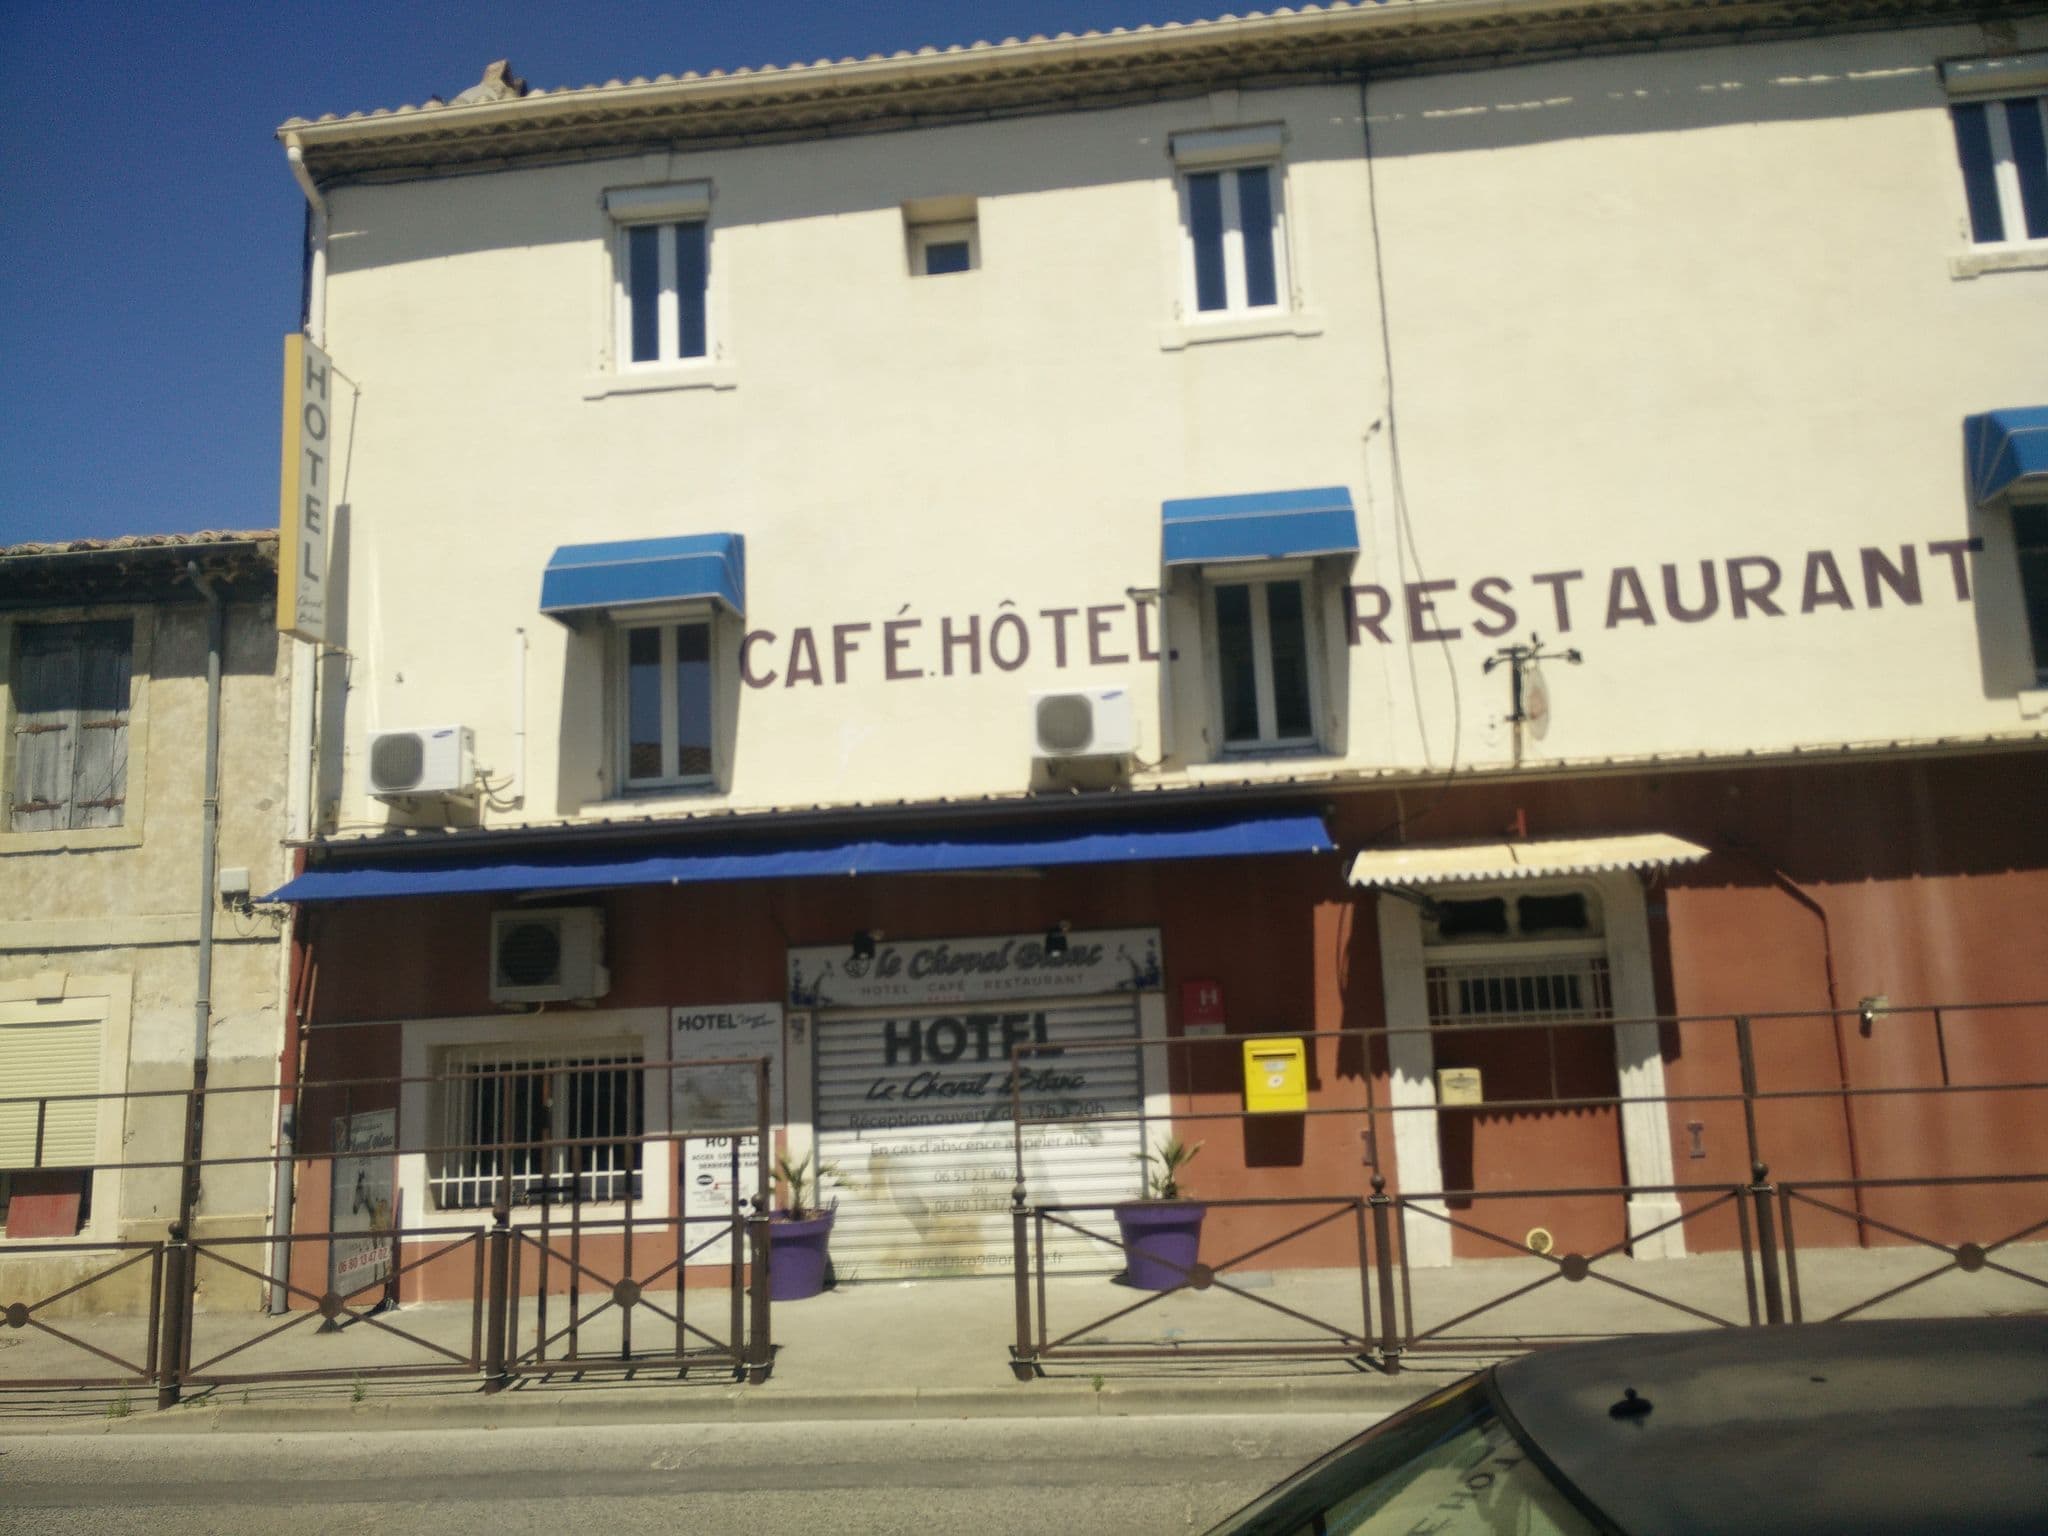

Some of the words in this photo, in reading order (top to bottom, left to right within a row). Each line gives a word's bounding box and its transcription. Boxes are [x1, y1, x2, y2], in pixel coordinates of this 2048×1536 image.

[304, 354, 326, 582] HOTEL
[1342, 537, 1984, 646] RESTAURANT
[984, 972, 1084, 990] RESTAURANT
[678, 1013, 737, 1032] HOTEL
[884, 1013, 1065, 1066] HOTEL
[706, 1136, 758, 1147] HOEL
